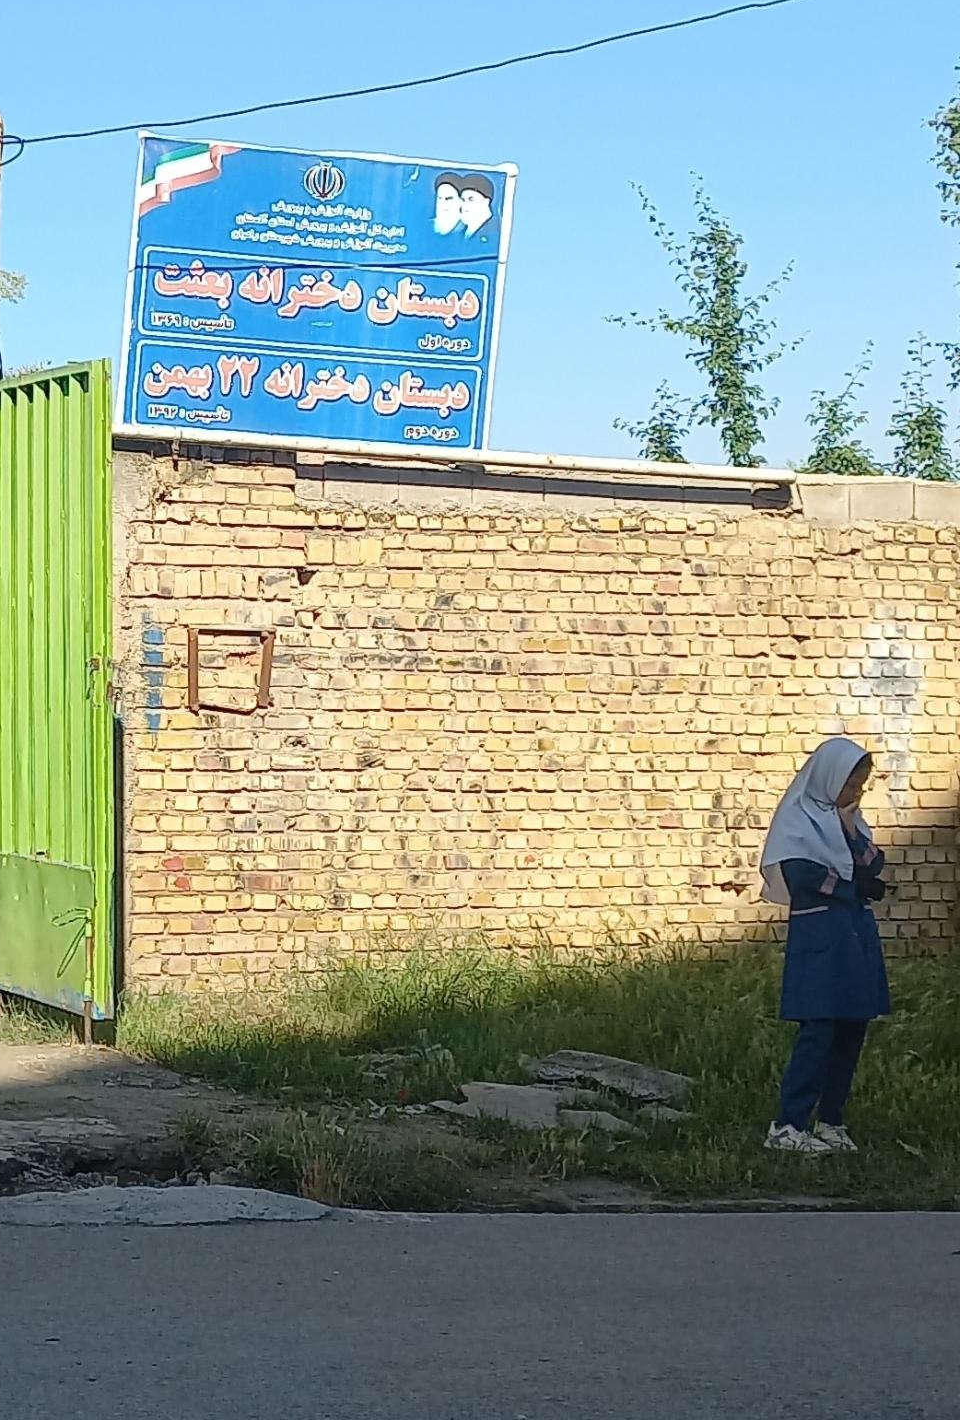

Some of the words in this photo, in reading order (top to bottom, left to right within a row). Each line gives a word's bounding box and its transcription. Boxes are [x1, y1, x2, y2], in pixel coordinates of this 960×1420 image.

[154, 259, 233, 310] بعثت
[238, 264, 363, 318] دخترانه
[366, 276, 480, 328] دبستان
[419, 334, 442, 349] اول
[442, 337, 470, 351] دوره
[143, 362, 213, 400] بهمن
[217, 354, 260, 397] ۲۲
[264, 360, 369, 411] دخترانه
[373, 370, 470, 418] دبستان
[431, 426, 459, 440] دوره
